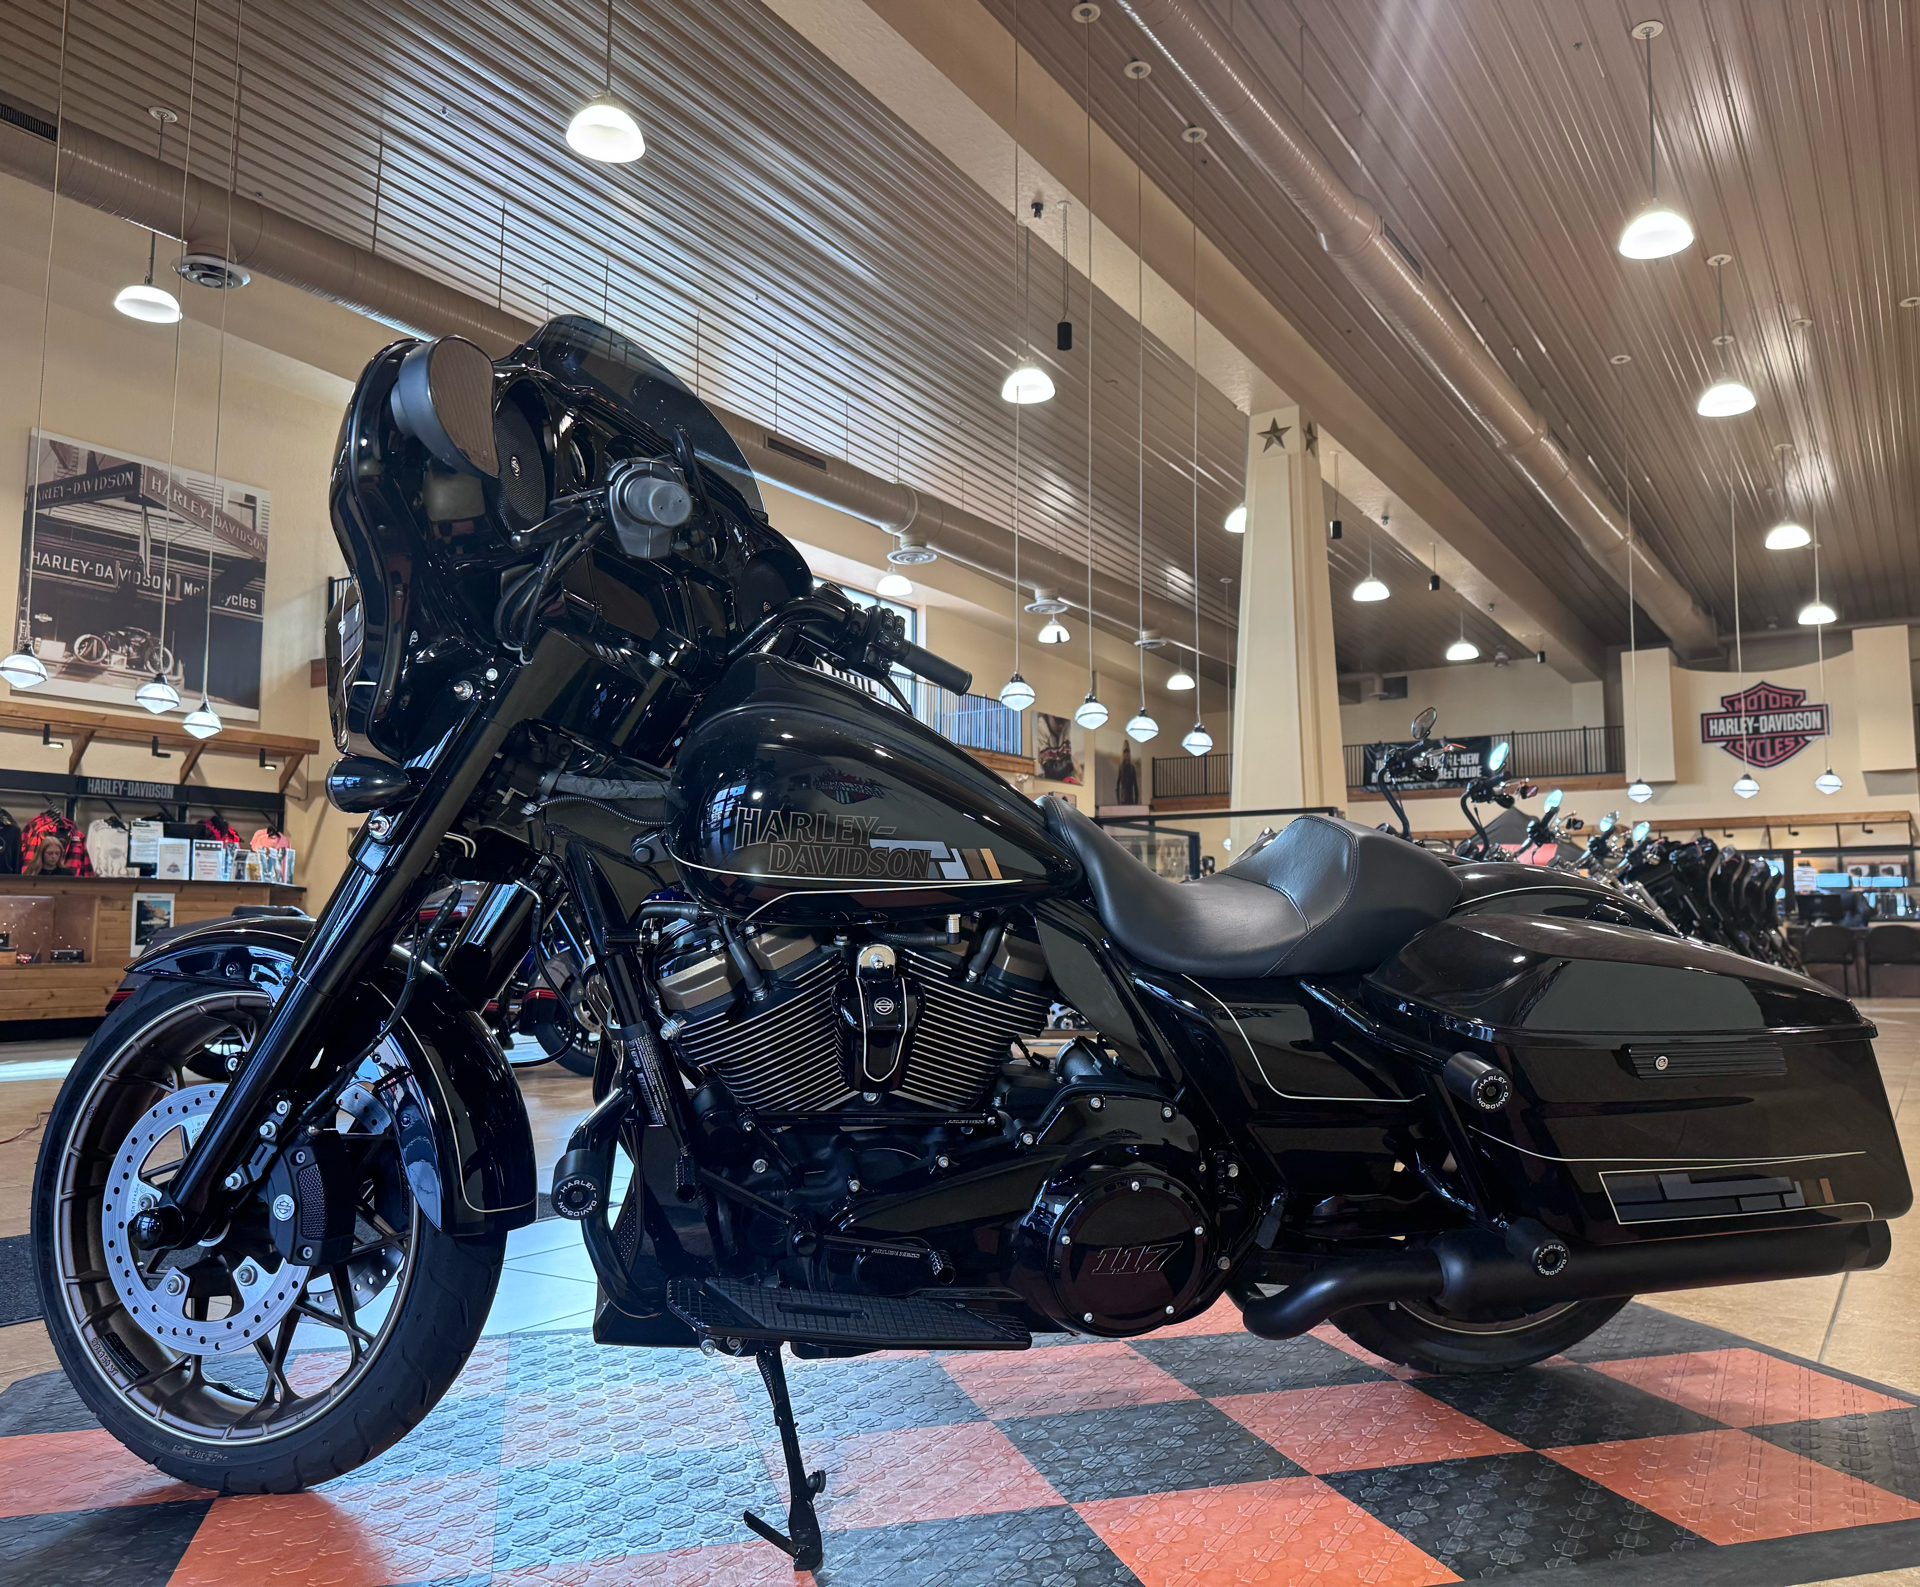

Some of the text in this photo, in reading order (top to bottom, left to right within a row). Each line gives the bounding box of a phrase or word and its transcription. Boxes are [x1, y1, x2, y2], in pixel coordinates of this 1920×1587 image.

[1734, 689, 1793, 711] MOTOR
[1709, 711, 1822, 737] HARLEY-DAVIDSON
[1735, 737, 1796, 761] CYCLES
[1459, 766, 1483, 779] GLIDE
[87, 778, 174, 799] HARLEY-DAVIDSON
[768, 843, 931, 879] DAVIDSON
[1091, 1240, 1184, 1275] 117
